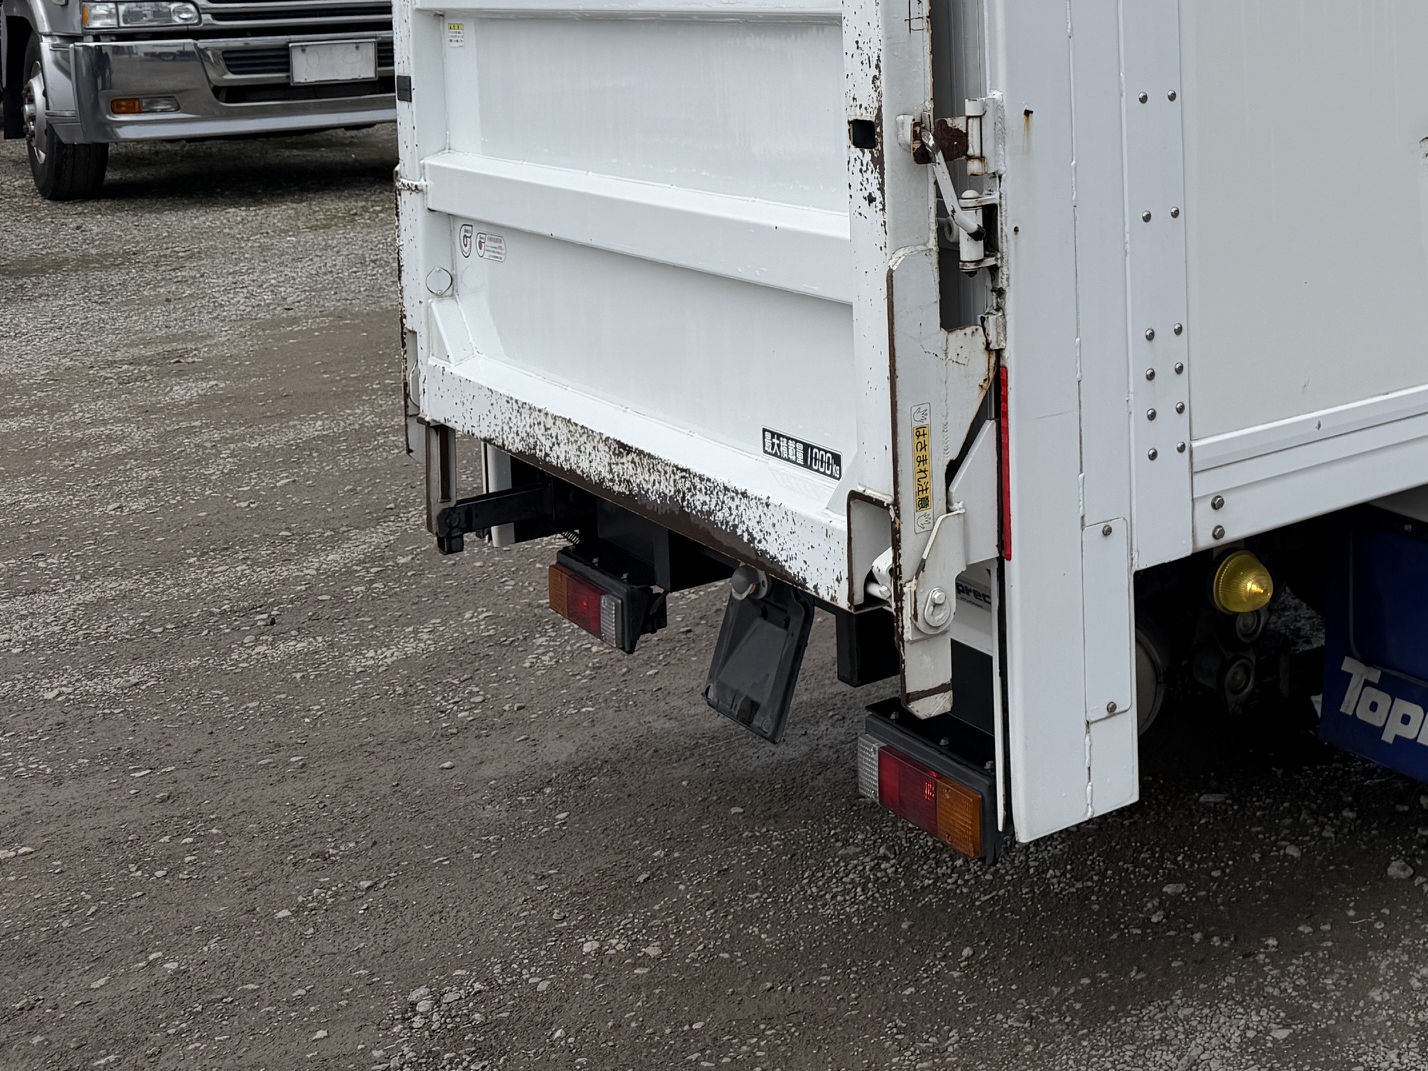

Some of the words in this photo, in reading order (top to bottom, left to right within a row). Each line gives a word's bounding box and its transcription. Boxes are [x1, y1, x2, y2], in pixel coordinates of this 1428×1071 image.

[764, 431, 804, 465] 最大積載量
